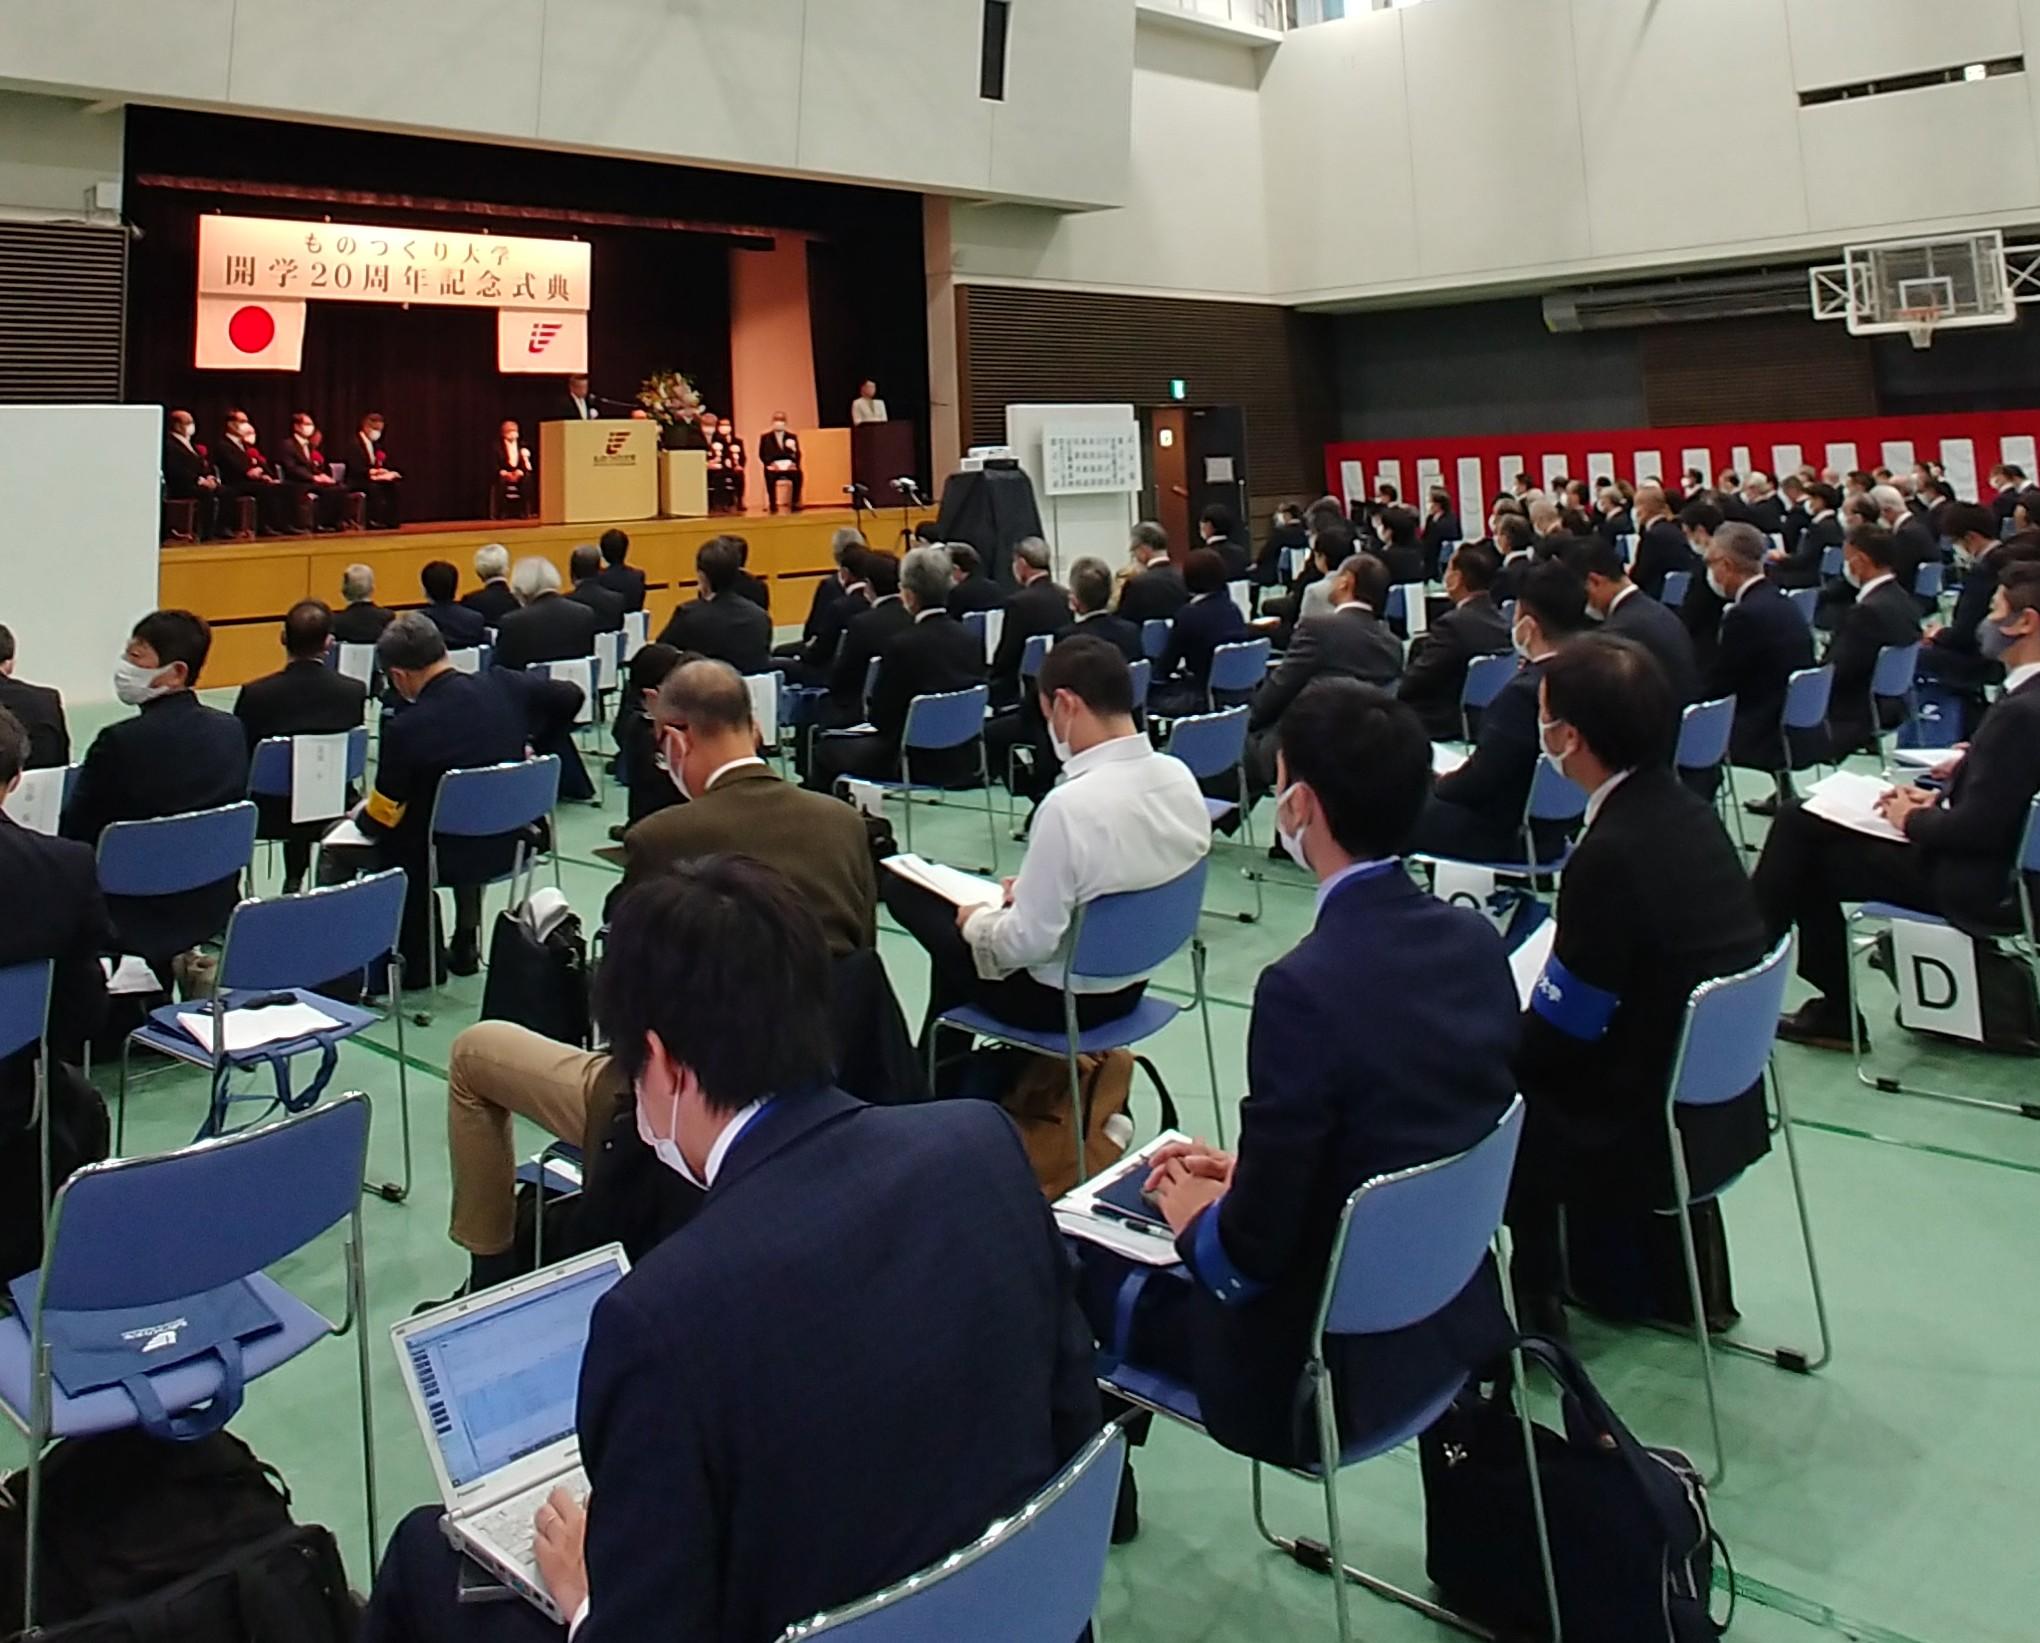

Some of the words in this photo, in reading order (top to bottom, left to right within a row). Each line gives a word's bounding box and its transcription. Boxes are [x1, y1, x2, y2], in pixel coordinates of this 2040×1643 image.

[304, 231, 510, 266] ものつくり大学
[225, 254, 571, 302] 開学20周年記念式典
[1912, 954, 1958, 1010] D
